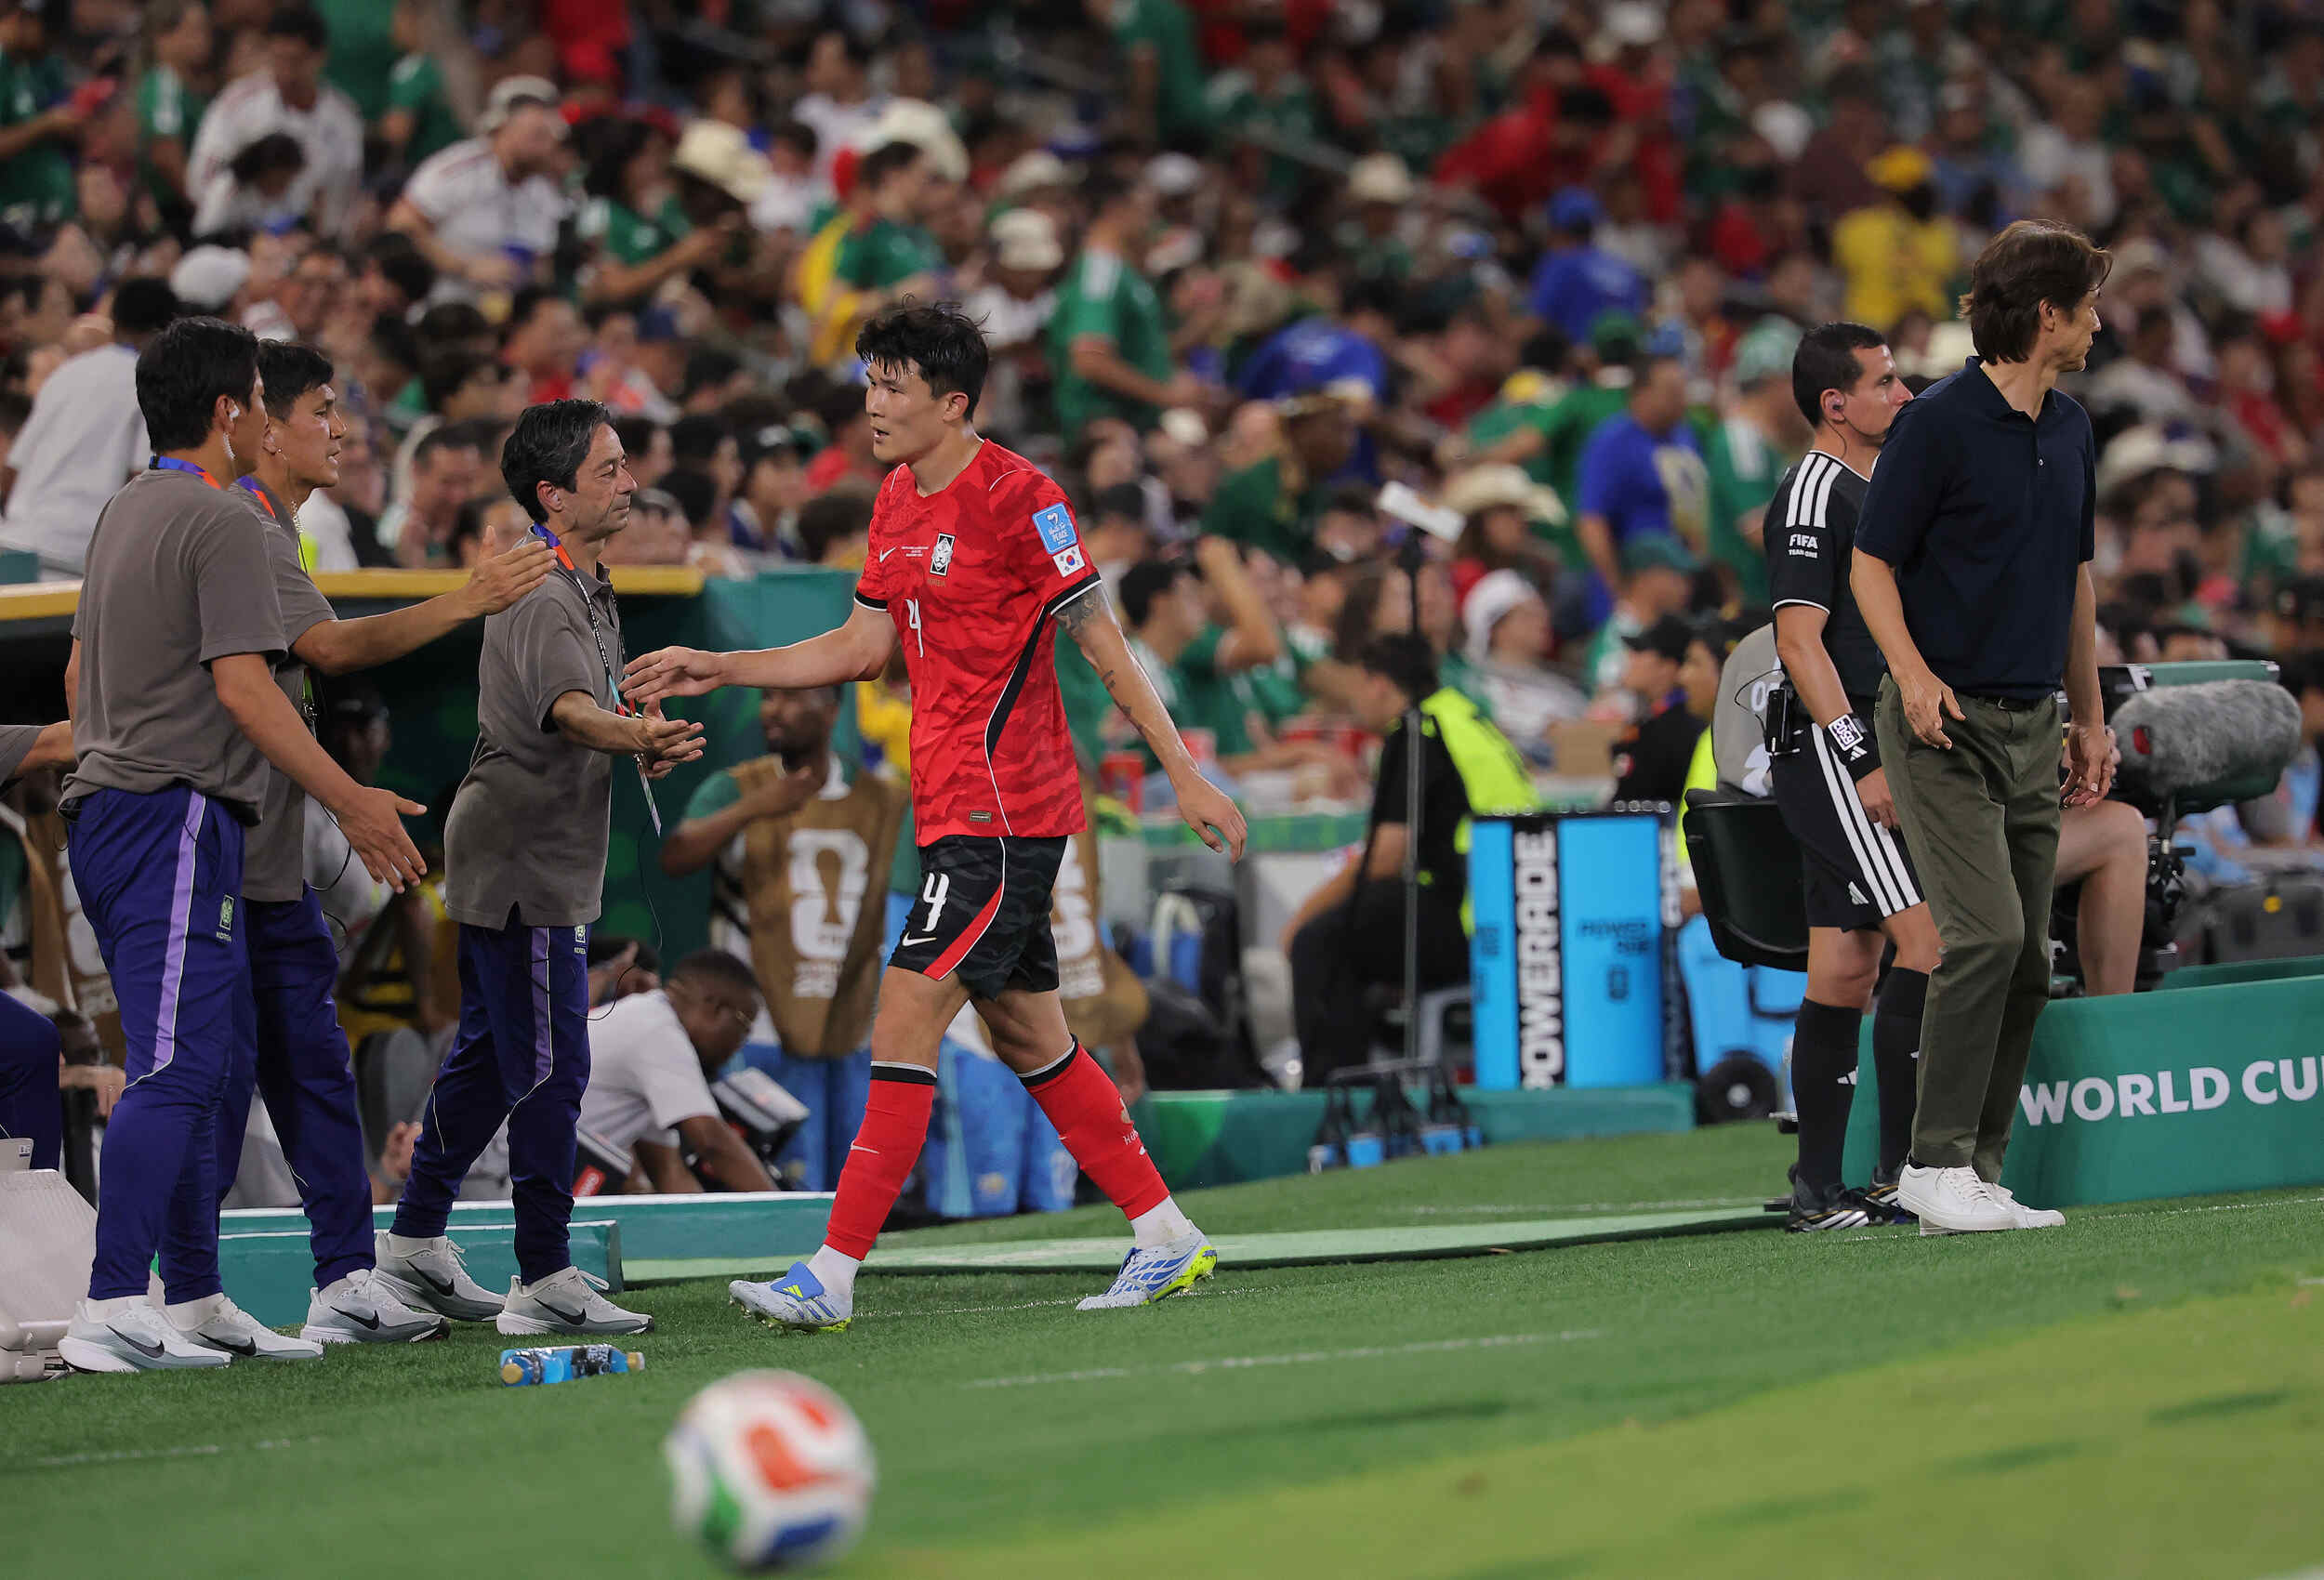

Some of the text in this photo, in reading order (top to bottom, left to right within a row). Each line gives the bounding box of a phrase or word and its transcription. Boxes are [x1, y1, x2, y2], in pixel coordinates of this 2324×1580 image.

[1789, 533, 1818, 549] FIFA
[905, 598, 924, 658] 4
[922, 872, 950, 932] 4
[2018, 1055, 2324, 1126] WORLD CU
